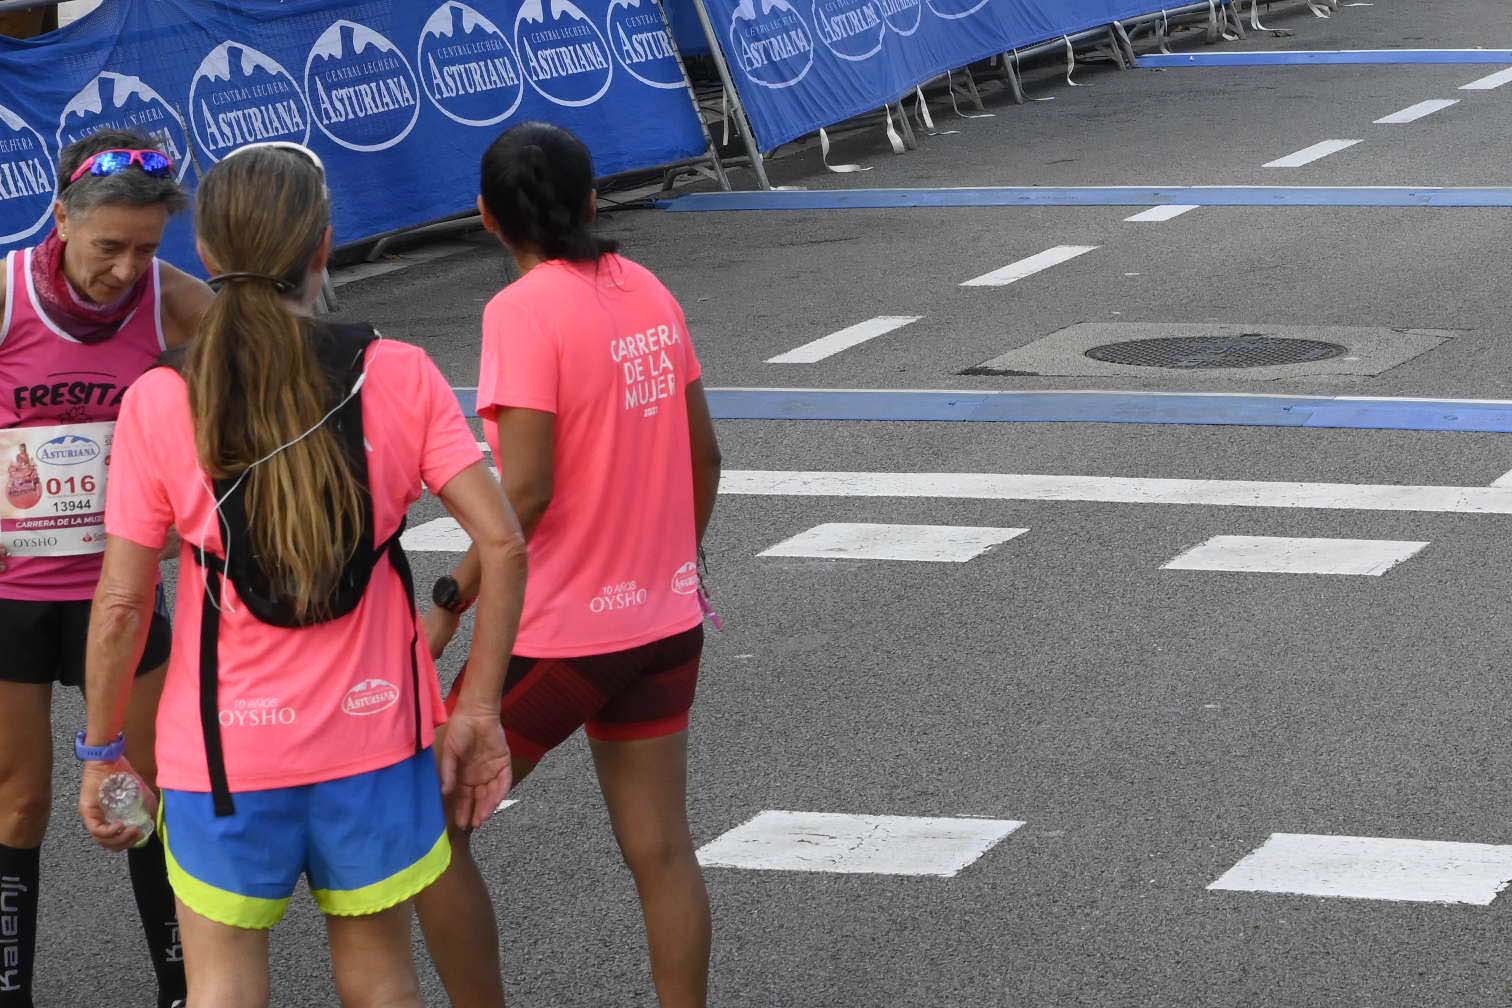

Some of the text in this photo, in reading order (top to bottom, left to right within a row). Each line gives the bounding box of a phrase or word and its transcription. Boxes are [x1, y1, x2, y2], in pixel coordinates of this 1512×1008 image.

[625, 14, 660, 28] CENTRAL
[531, 25, 591, 43] CENTRAL LECHERA
[437, 39, 504, 59] CENTRAL LECHERA
[522, 36, 609, 82] ASTURIANA
[325, 57, 400, 82] CENTRAL LECHERA
[428, 52, 520, 100] ASTURIANA
[212, 80, 290, 105] CENTRAL LECHERA
[315, 75, 416, 126] ASTURIANA
[200, 97, 305, 151] ASTURIANA
[610, 321, 680, 363] CARRERA
[623, 353, 674, 384] DE LA
[625, 373, 677, 411] MUJER
[41, 447, 97, 459] ASTURIANA
[46, 474, 96, 496] 016
[53, 499, 92, 513] 13944
[15, 517, 82, 528] CARRERA DE LA
[13, 536, 58, 548] OYSHO
[590, 588, 648, 614] OYSHO
[218, 707, 296, 727] OYSHO
